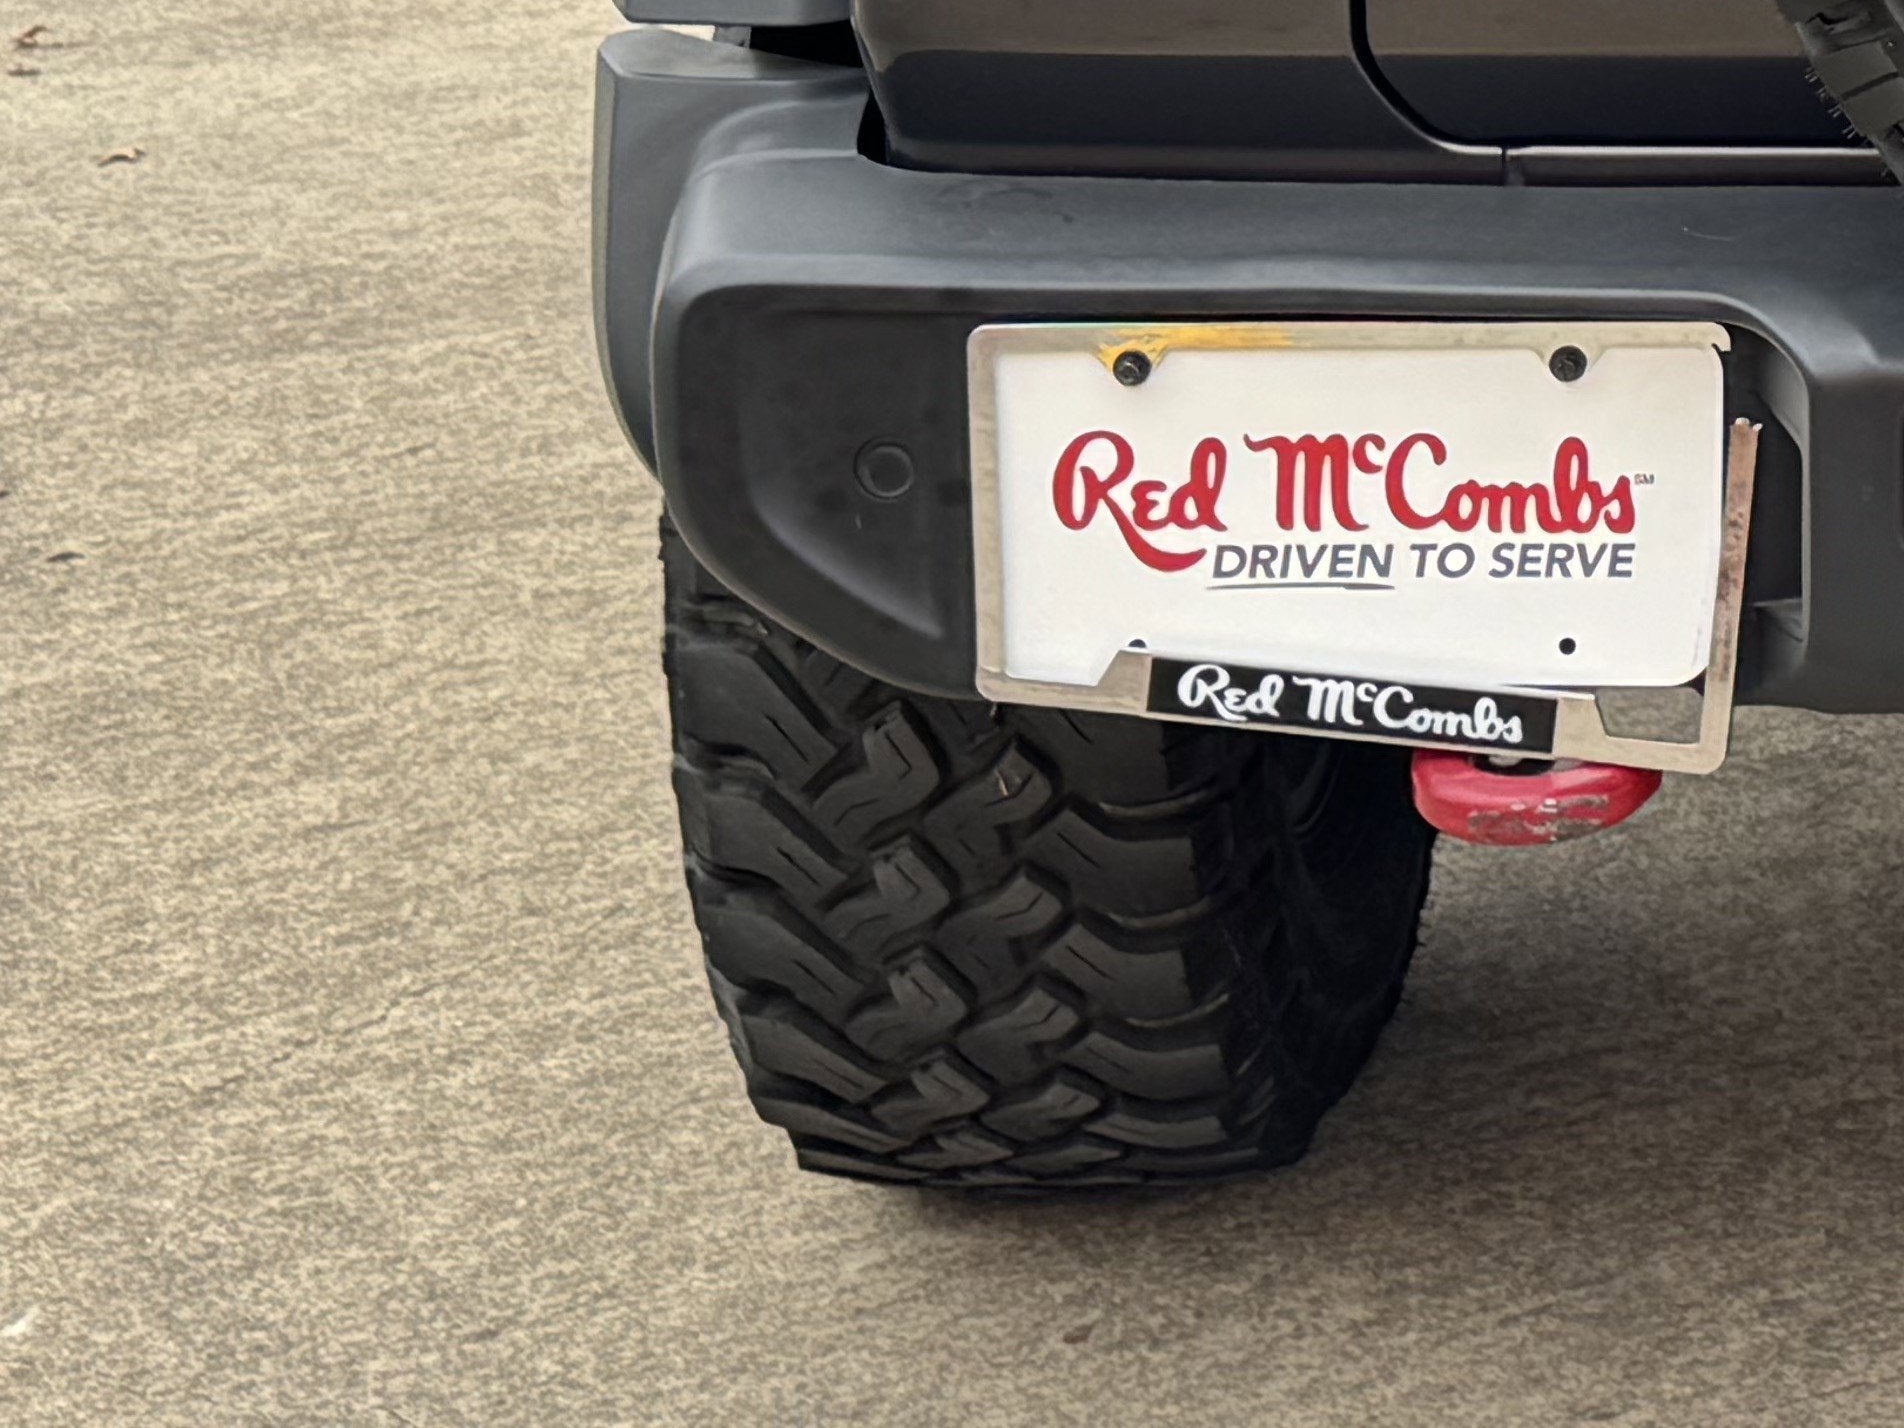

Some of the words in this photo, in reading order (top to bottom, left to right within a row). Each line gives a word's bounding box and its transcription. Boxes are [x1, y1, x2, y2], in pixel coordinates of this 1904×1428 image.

[1052, 429, 1228, 573] Red
[1243, 432, 1636, 535] McCombs
[1211, 543, 1393, 579] DRIVEN
[1411, 542, 1477, 578] TO
[1488, 542, 1635, 579] SERVE
[1177, 663, 1279, 720] Red
[1291, 676, 1525, 744] McCombs
